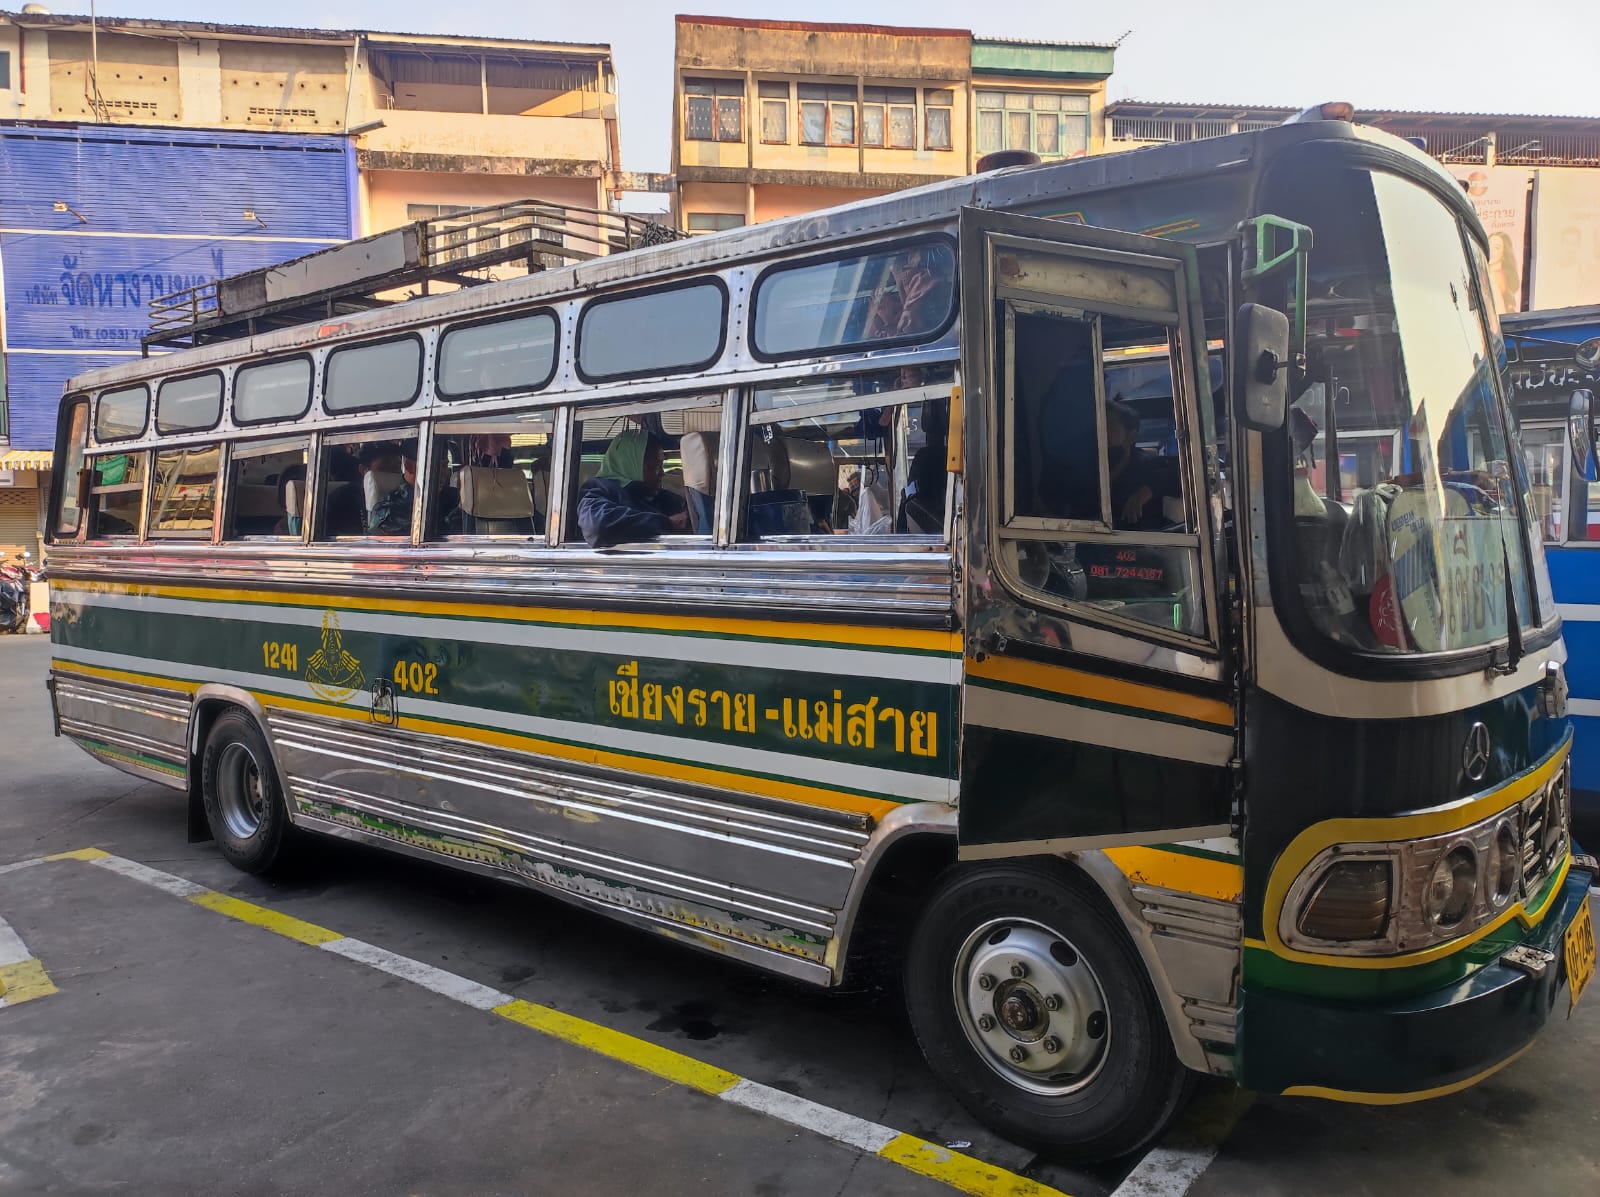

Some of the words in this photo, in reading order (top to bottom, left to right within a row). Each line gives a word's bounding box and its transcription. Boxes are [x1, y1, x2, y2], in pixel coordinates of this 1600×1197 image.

[95, 328, 129, 341] (053)
[262, 640, 298, 672] 1241
[393, 660, 439, 695] 402
